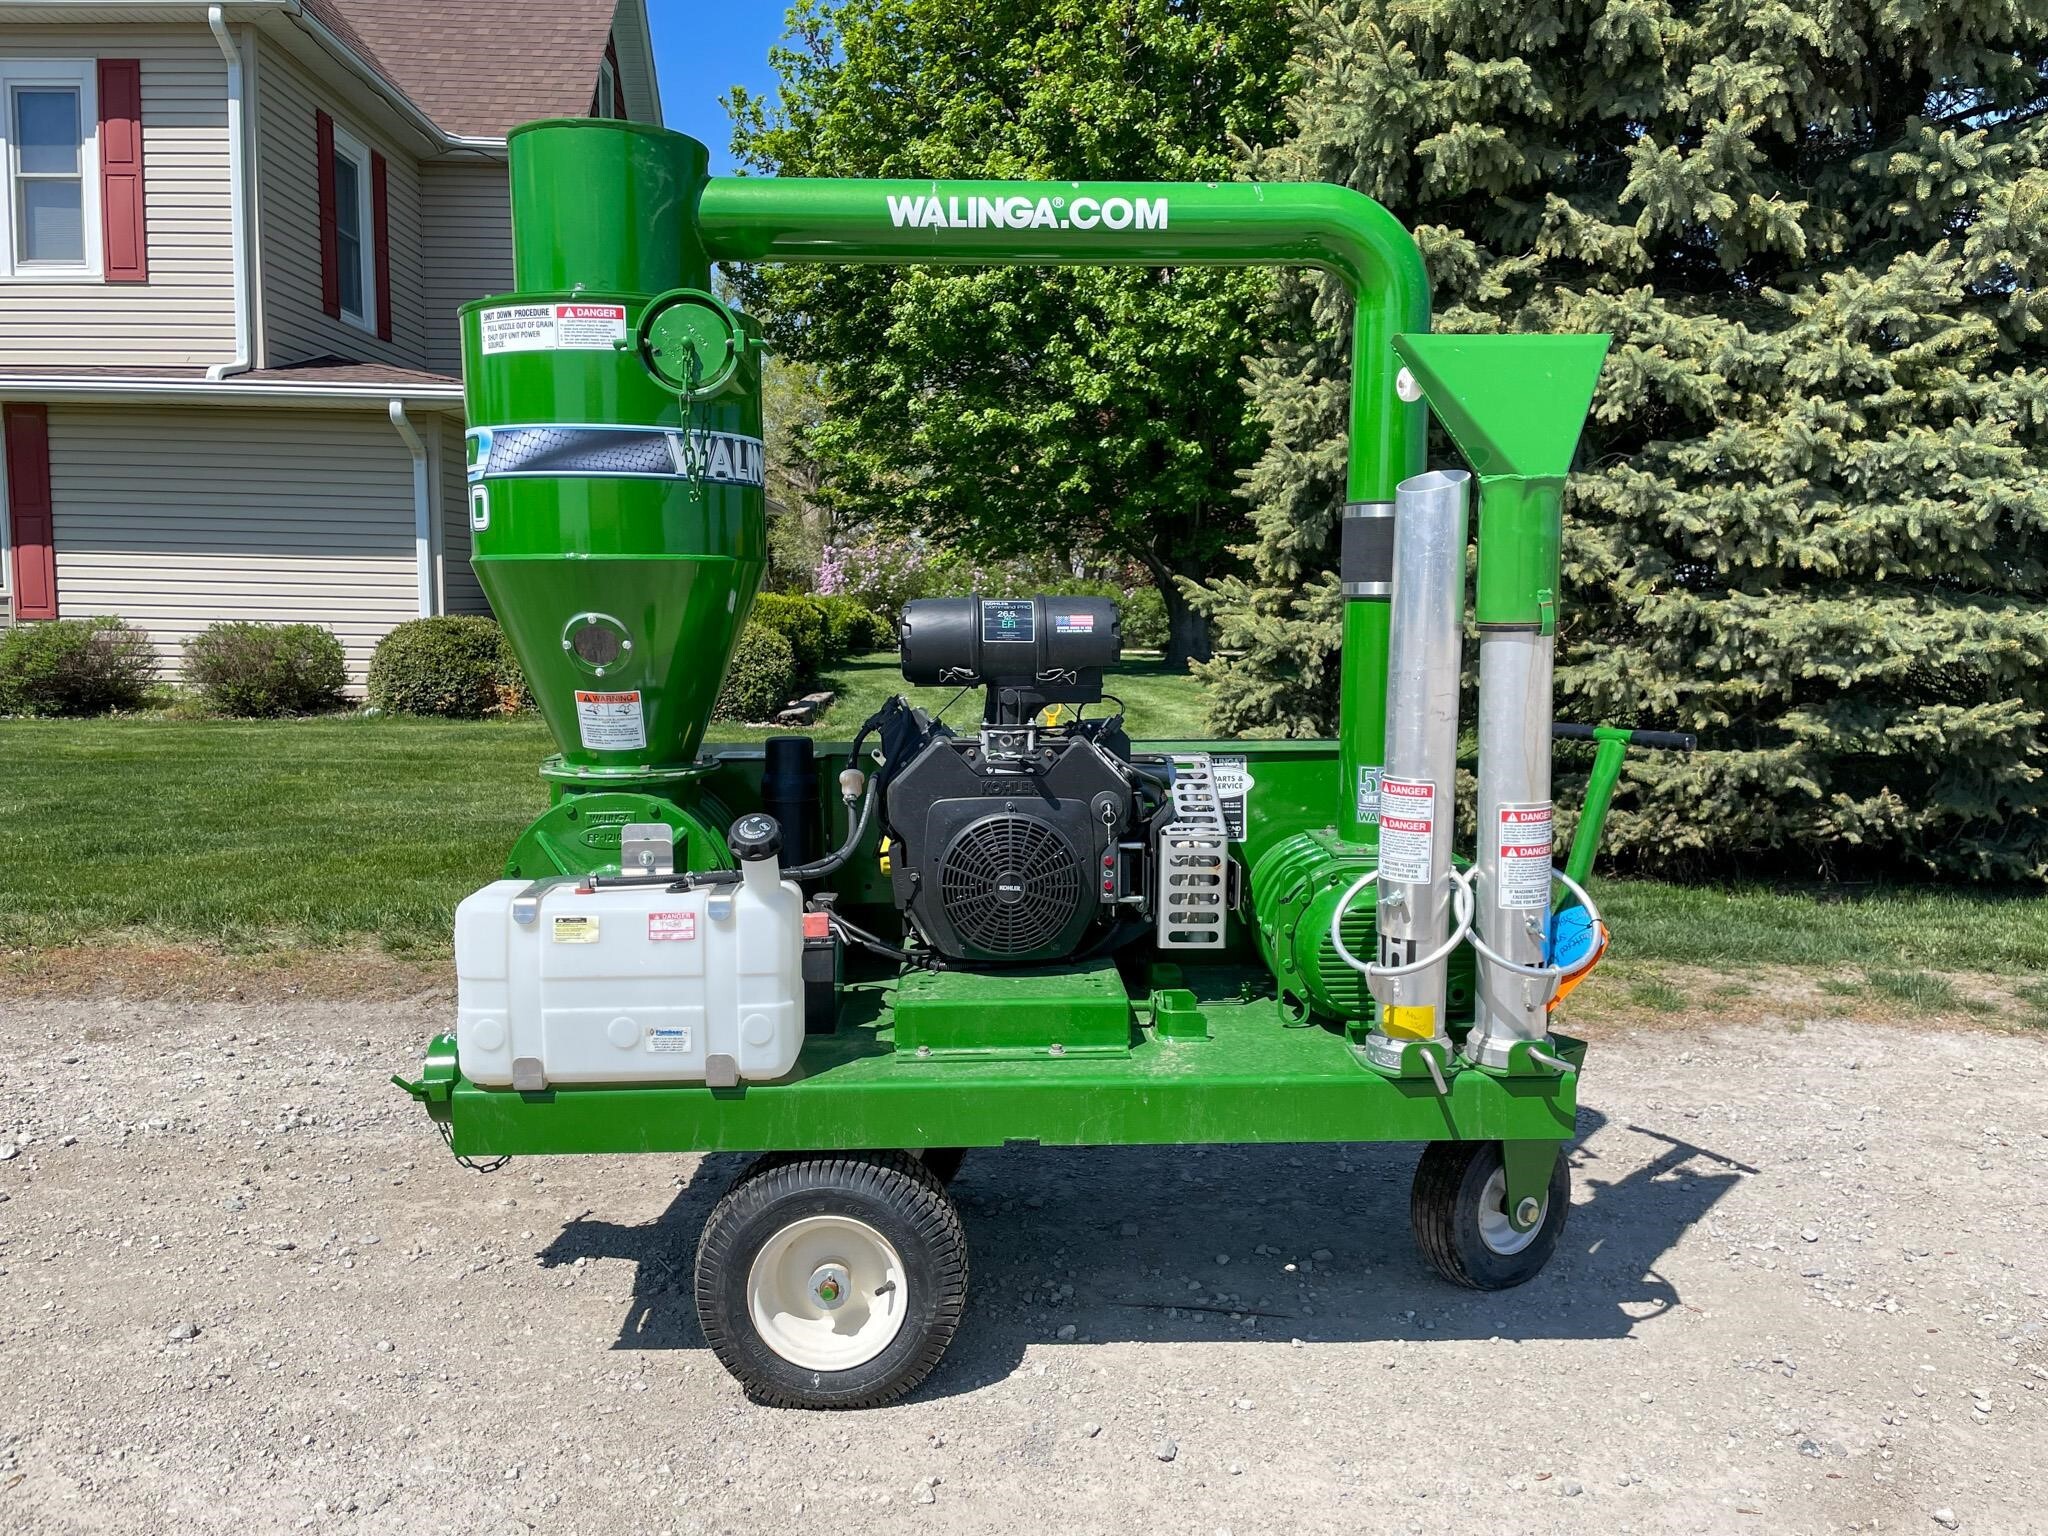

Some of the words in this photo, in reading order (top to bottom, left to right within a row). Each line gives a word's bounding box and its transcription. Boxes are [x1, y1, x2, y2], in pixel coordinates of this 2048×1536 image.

[484, 312, 495, 321] SHUT
[497, 310, 512, 319] DOWN
[514, 308, 550, 317] PROCEDURE
[577, 308, 617, 317] DANGER
[498, 322, 515, 331] NOZZLE
[516, 321, 526, 329] OUT
[536, 320, 554, 328] GRAIN
[499, 332, 507, 340] OFF
[508, 331, 520, 339] UNIT
[521, 330, 540, 338] POWER
[1002, 620, 1016, 629] EFI
[593, 694, 633, 702] WARNING
[1390, 784, 1428, 796] DANGER
[1389, 819, 1426, 831] DANGER
